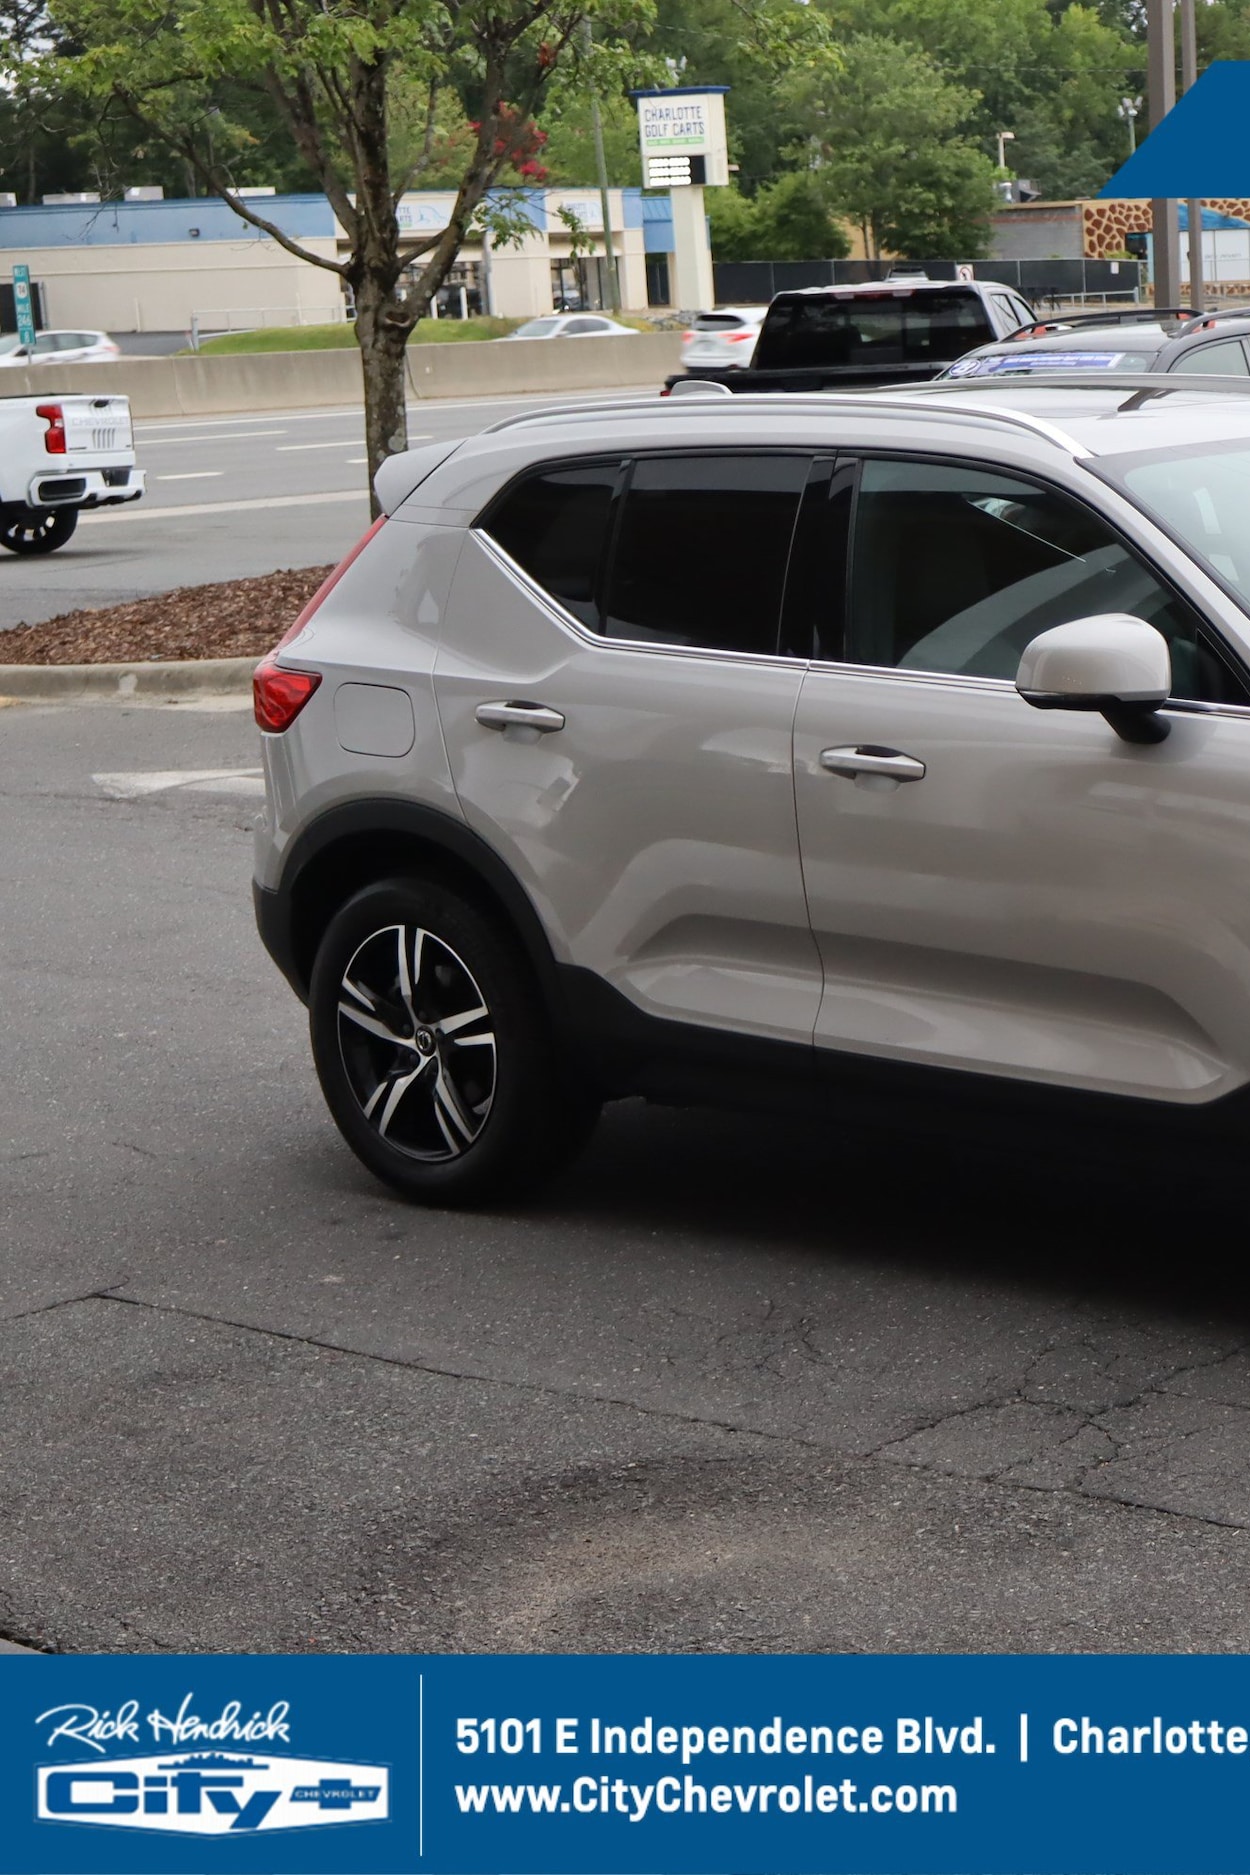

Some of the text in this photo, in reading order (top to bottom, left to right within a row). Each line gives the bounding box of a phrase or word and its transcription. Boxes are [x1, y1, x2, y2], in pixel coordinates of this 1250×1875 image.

[644, 106, 703, 122] CHARLOTTE
[644, 121, 705, 137] GOLF CARTS
